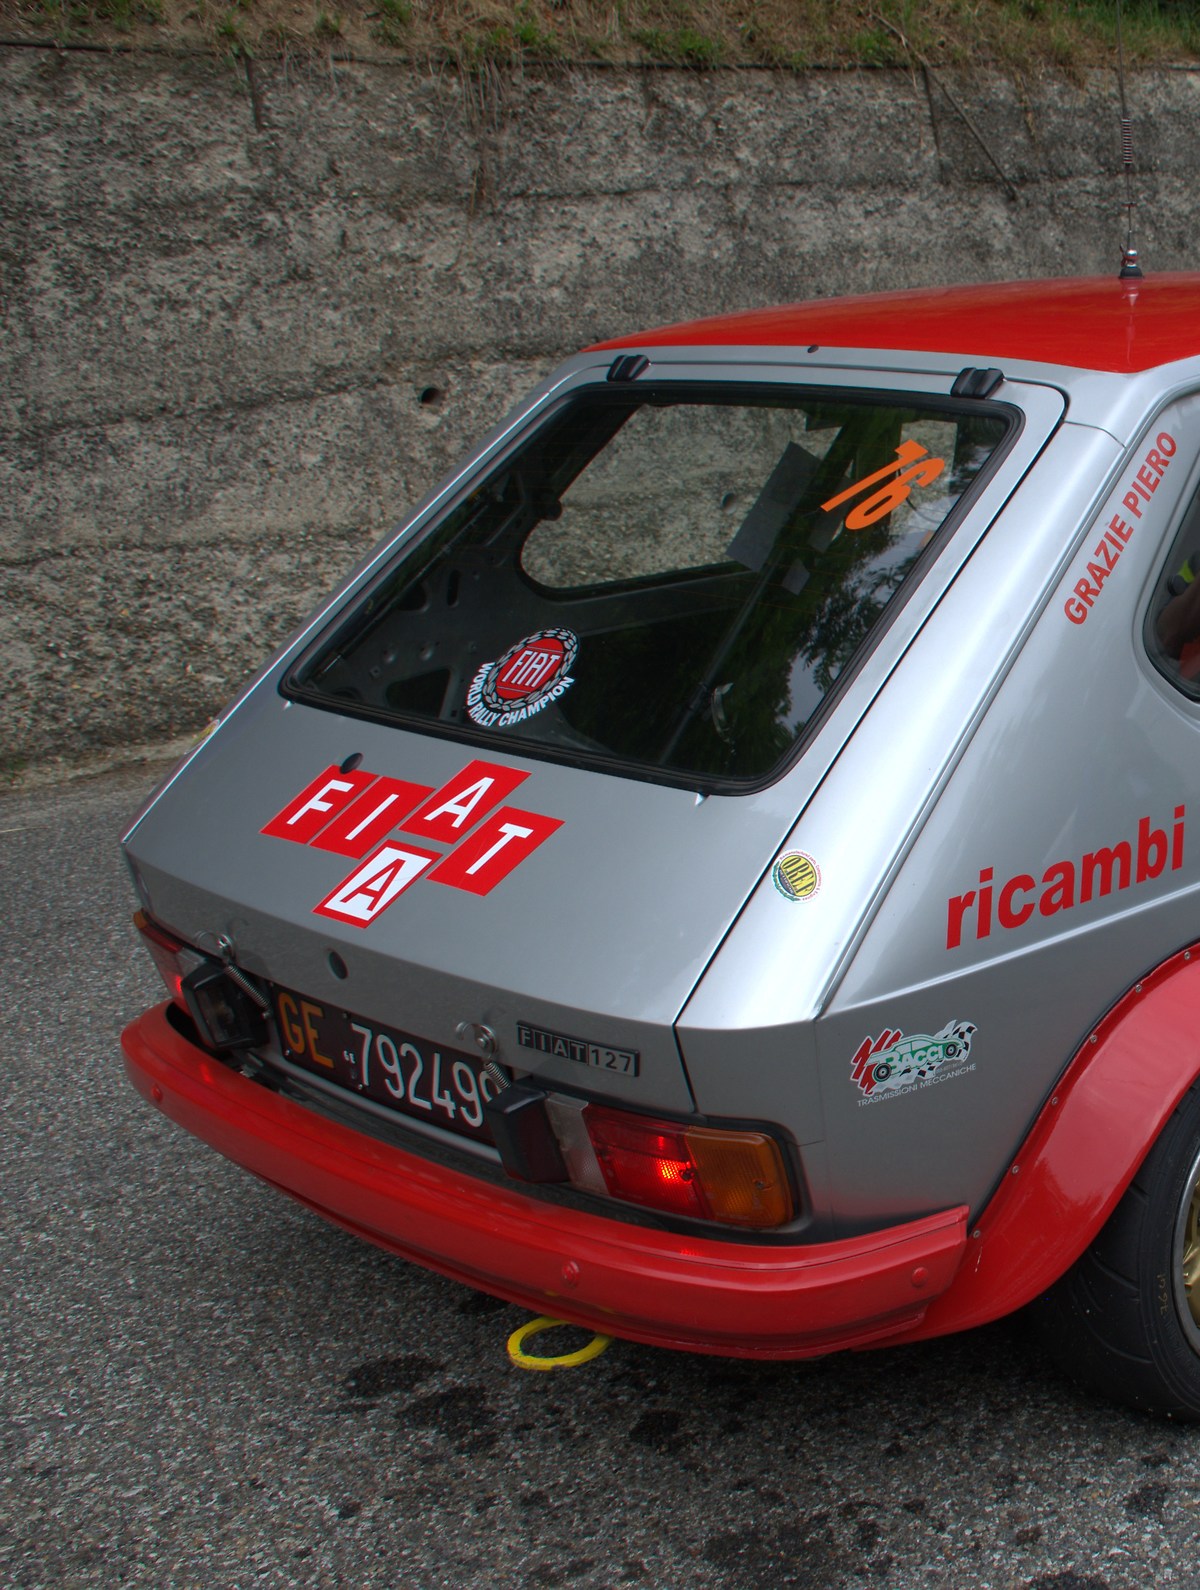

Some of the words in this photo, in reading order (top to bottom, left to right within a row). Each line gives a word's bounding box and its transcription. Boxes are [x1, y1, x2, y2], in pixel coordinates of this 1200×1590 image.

[1064, 514, 1134, 625] GRAZIE
[1122, 432, 1177, 519] PIERO
[467, 662, 496, 706] WORLD
[502, 650, 560, 687] FIAT
[469, 703, 501, 726] RALLY
[498, 676, 574, 726] CHAMPION
[286, 776, 532, 876] FIAT
[947, 805, 1186, 950] ricambi
[277, 991, 334, 1068] GE
[520, 1026, 587, 1063] FIAT
[591, 1048, 636, 1075] 127
[884, 1045, 944, 1075] BACCI
[857, 1084, 918, 1108] TRASMISSIONI
[920, 1063, 977, 1089] MECCANICHE
